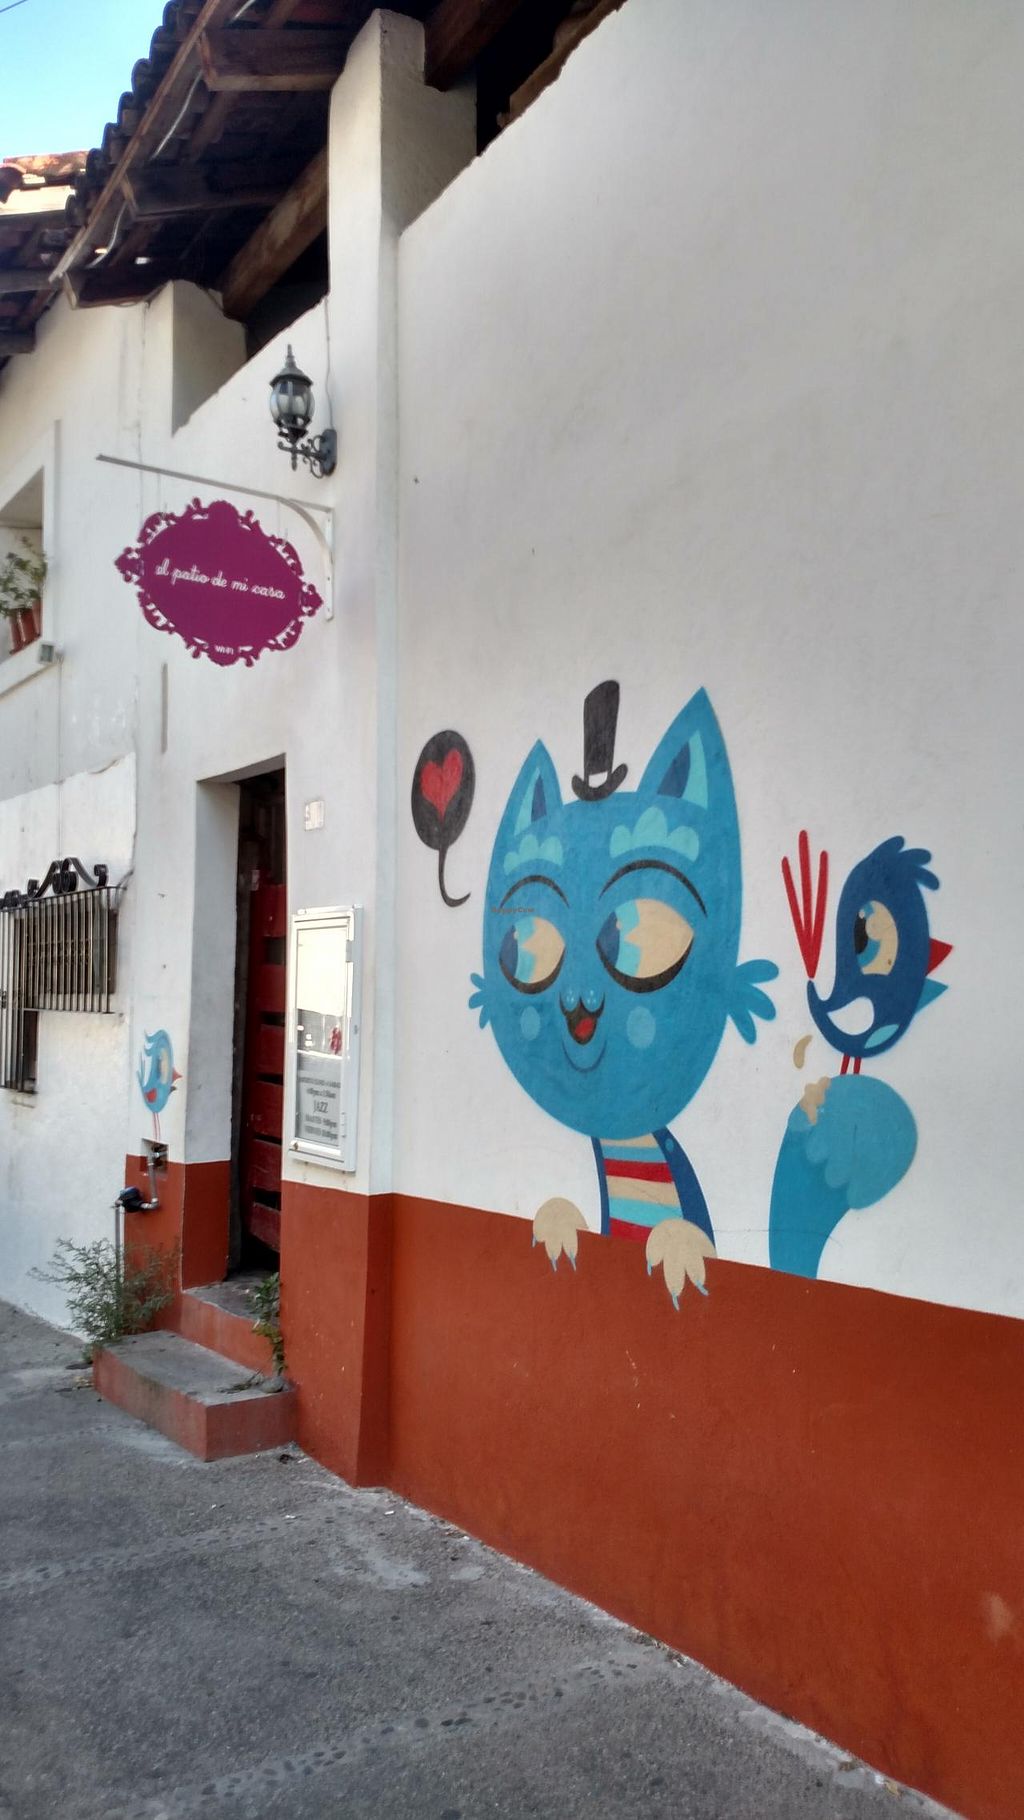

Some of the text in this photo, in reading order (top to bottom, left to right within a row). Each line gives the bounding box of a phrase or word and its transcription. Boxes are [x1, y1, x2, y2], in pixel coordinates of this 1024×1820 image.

[171, 565, 209, 585] patio
[211, 570, 227, 588] de
[231, 577, 248, 592] mi
[251, 584, 285, 600] casa
